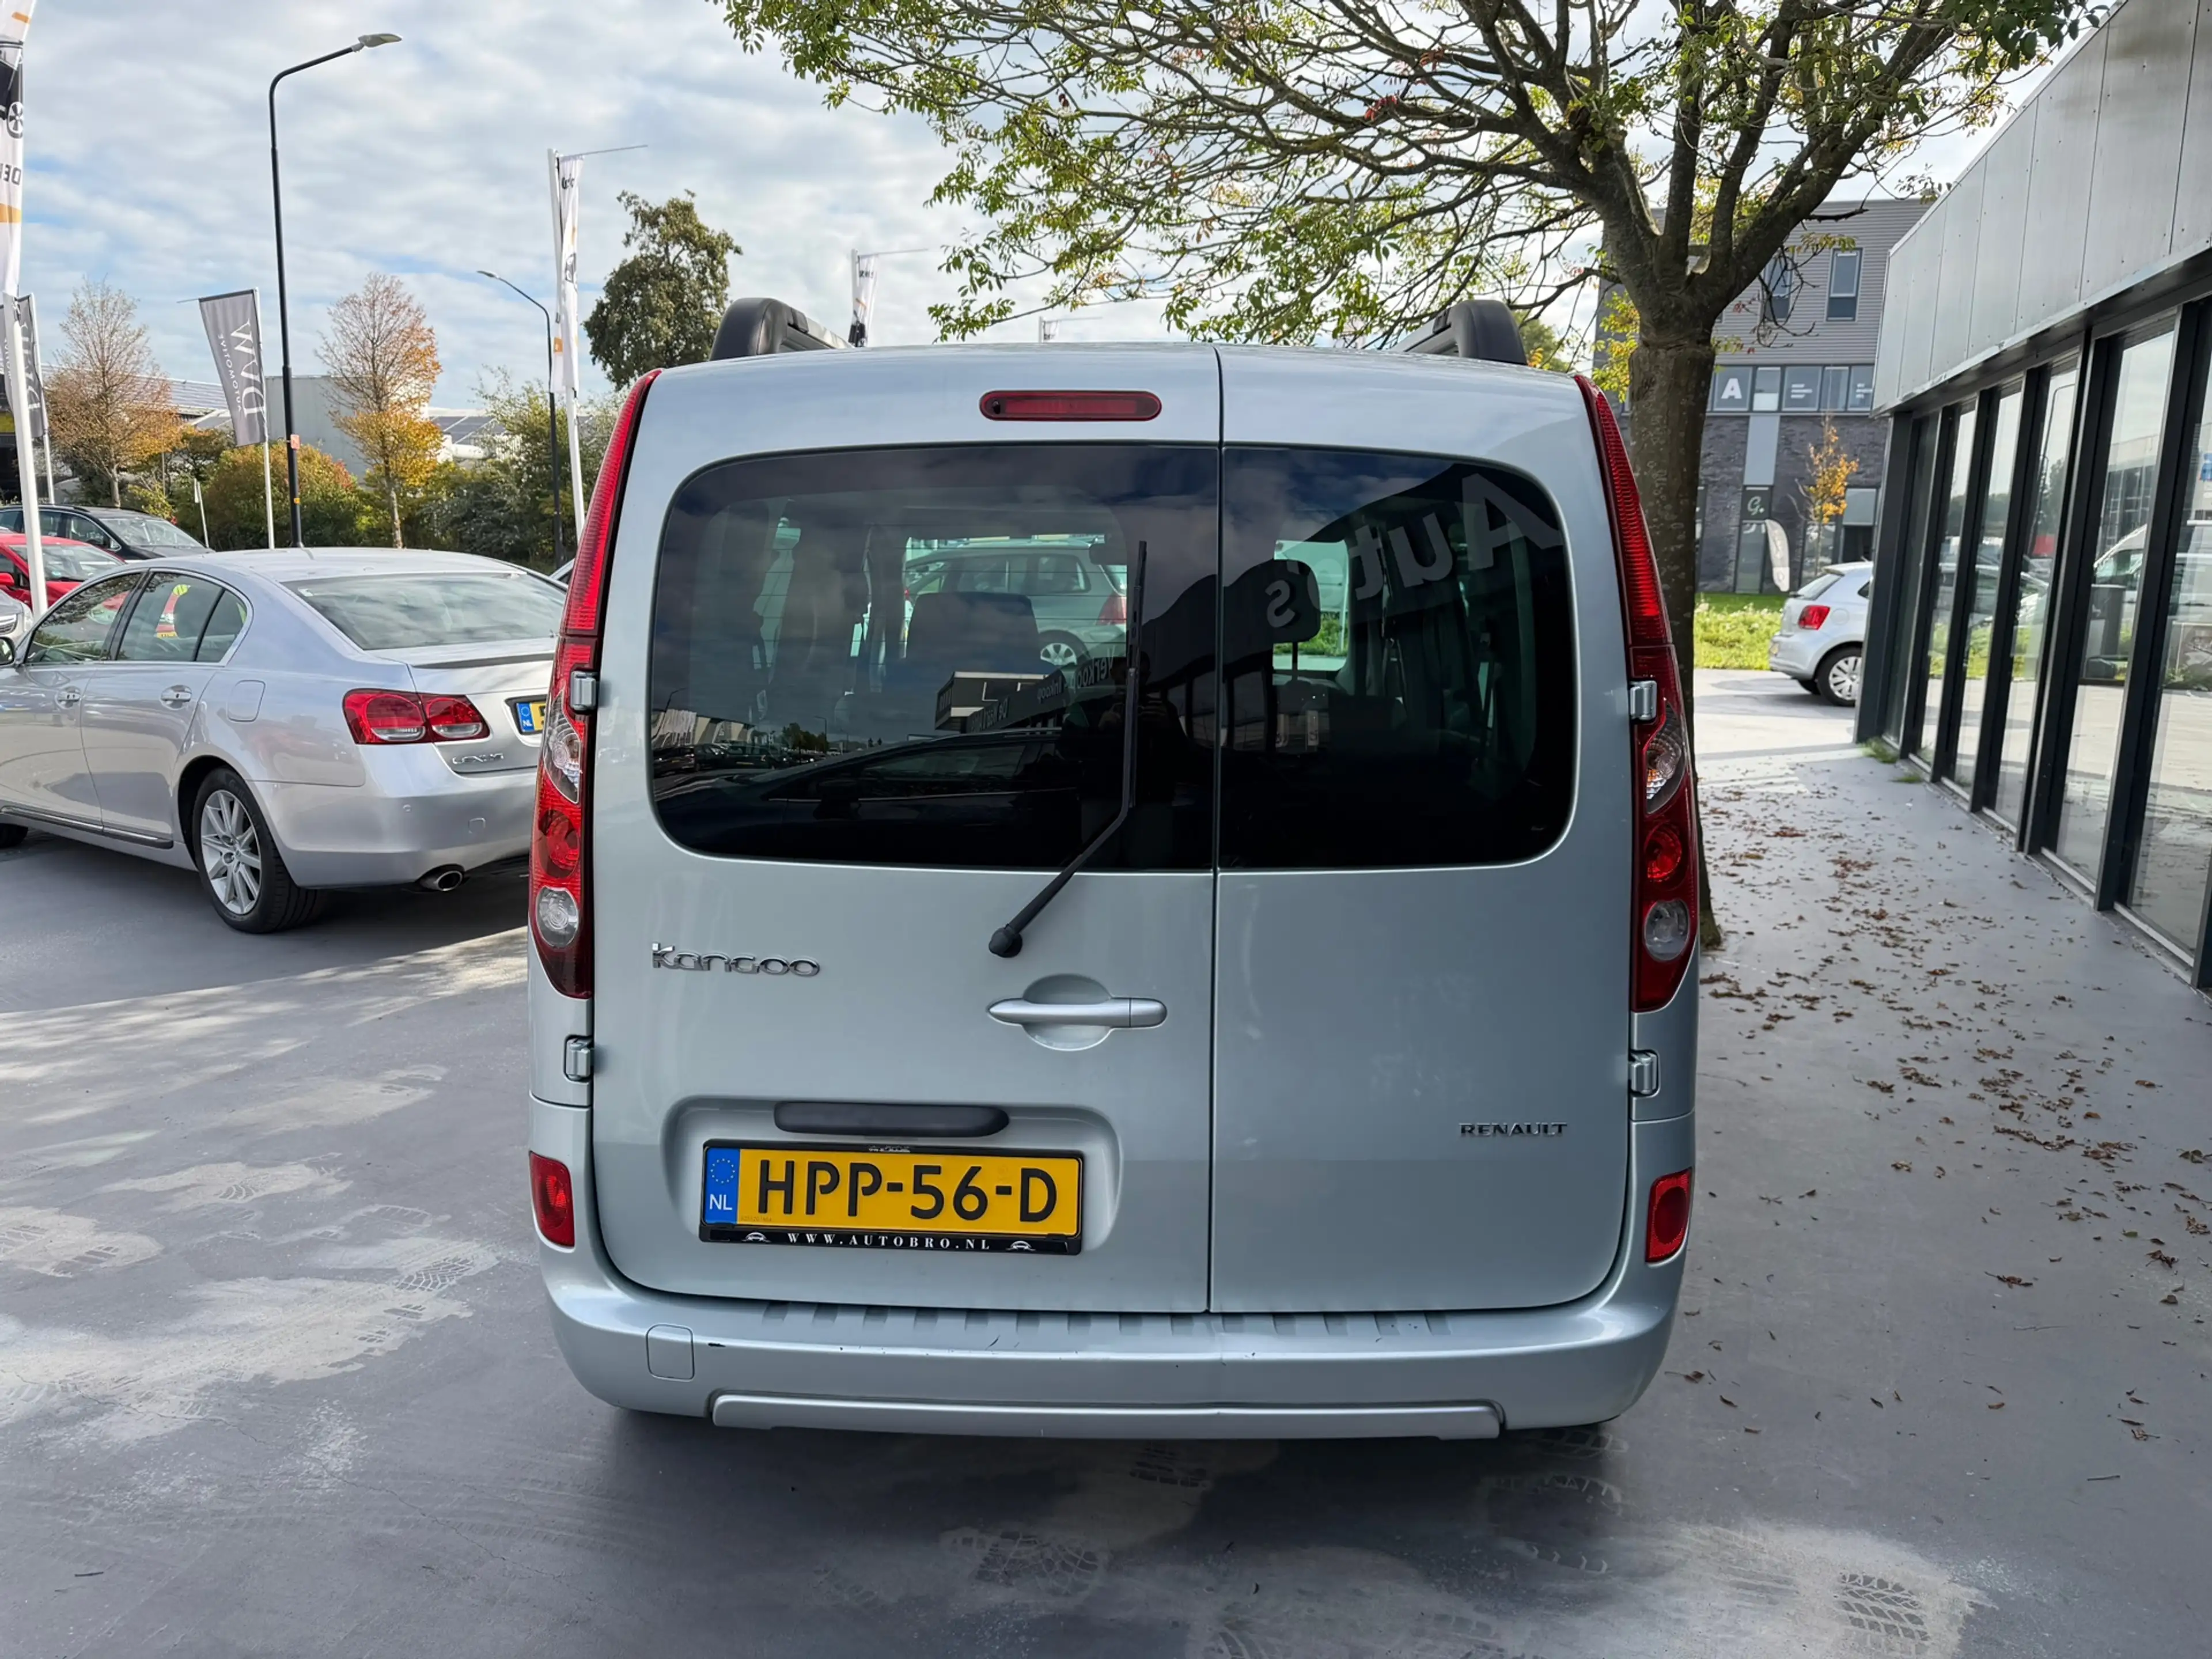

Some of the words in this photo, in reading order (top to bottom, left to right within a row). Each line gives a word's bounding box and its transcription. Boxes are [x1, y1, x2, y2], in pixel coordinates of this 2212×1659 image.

[1460, 1122, 1568, 1137] RENAULT
[710, 1194, 733, 1210] NL
[757, 1159, 1057, 1223] HPP-56-D
[787, 1232, 990, 1251] WWW.AUTOBRO.NL
